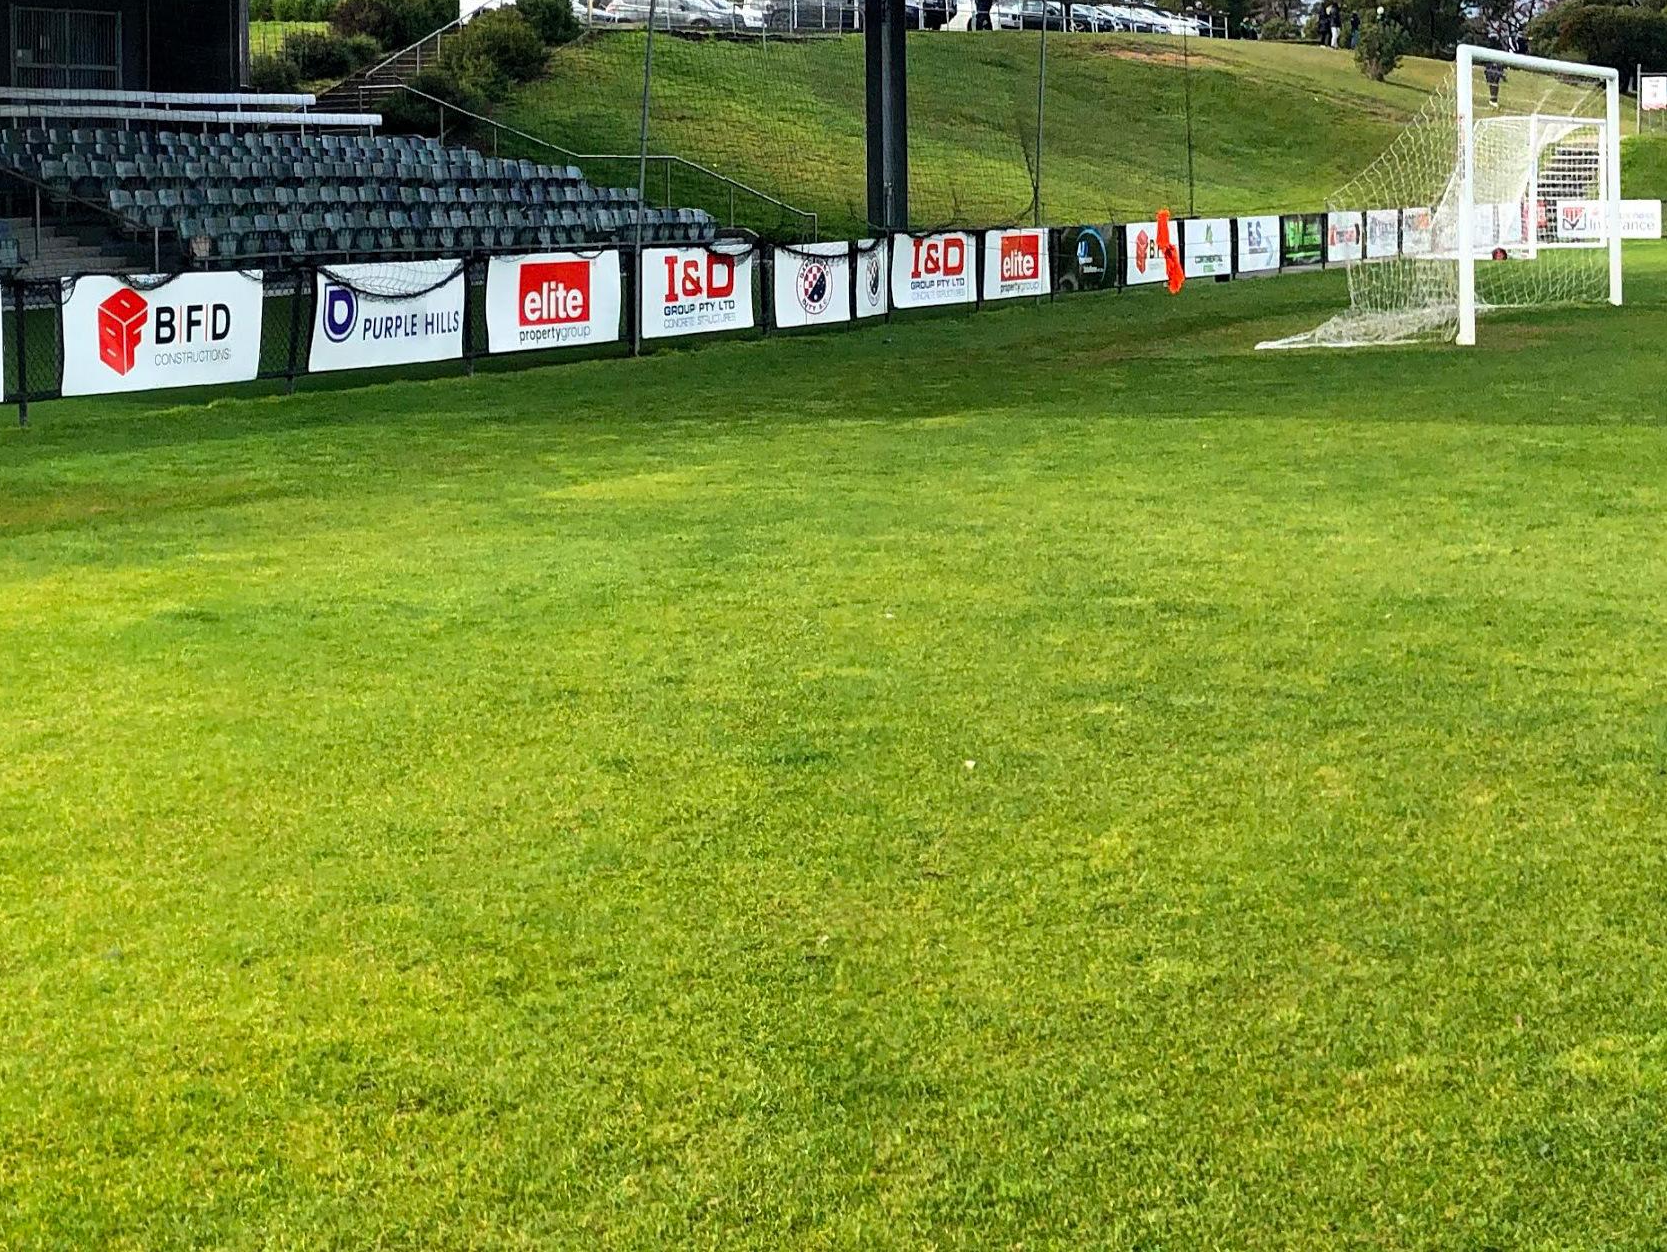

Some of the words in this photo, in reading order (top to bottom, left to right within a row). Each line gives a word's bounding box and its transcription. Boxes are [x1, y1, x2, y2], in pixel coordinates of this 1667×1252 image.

[911, 237, 965, 280] I&D
[1003, 251, 1035, 279] elite
[664, 252, 735, 303] I&D
[910, 280, 936, 291] GROUP
[936, 278, 950, 289] PTY
[951, 277, 965, 288] LTD
[524, 280, 583, 321] elite
[663, 303, 696, 317] GROUP
[698, 301, 716, 314] PTY
[718, 300, 735, 311] LTD
[362, 313, 418, 341] PURPLE
[424, 310, 460, 336] HILLS
[154, 347, 232, 367] CONSTRUCTIONS
